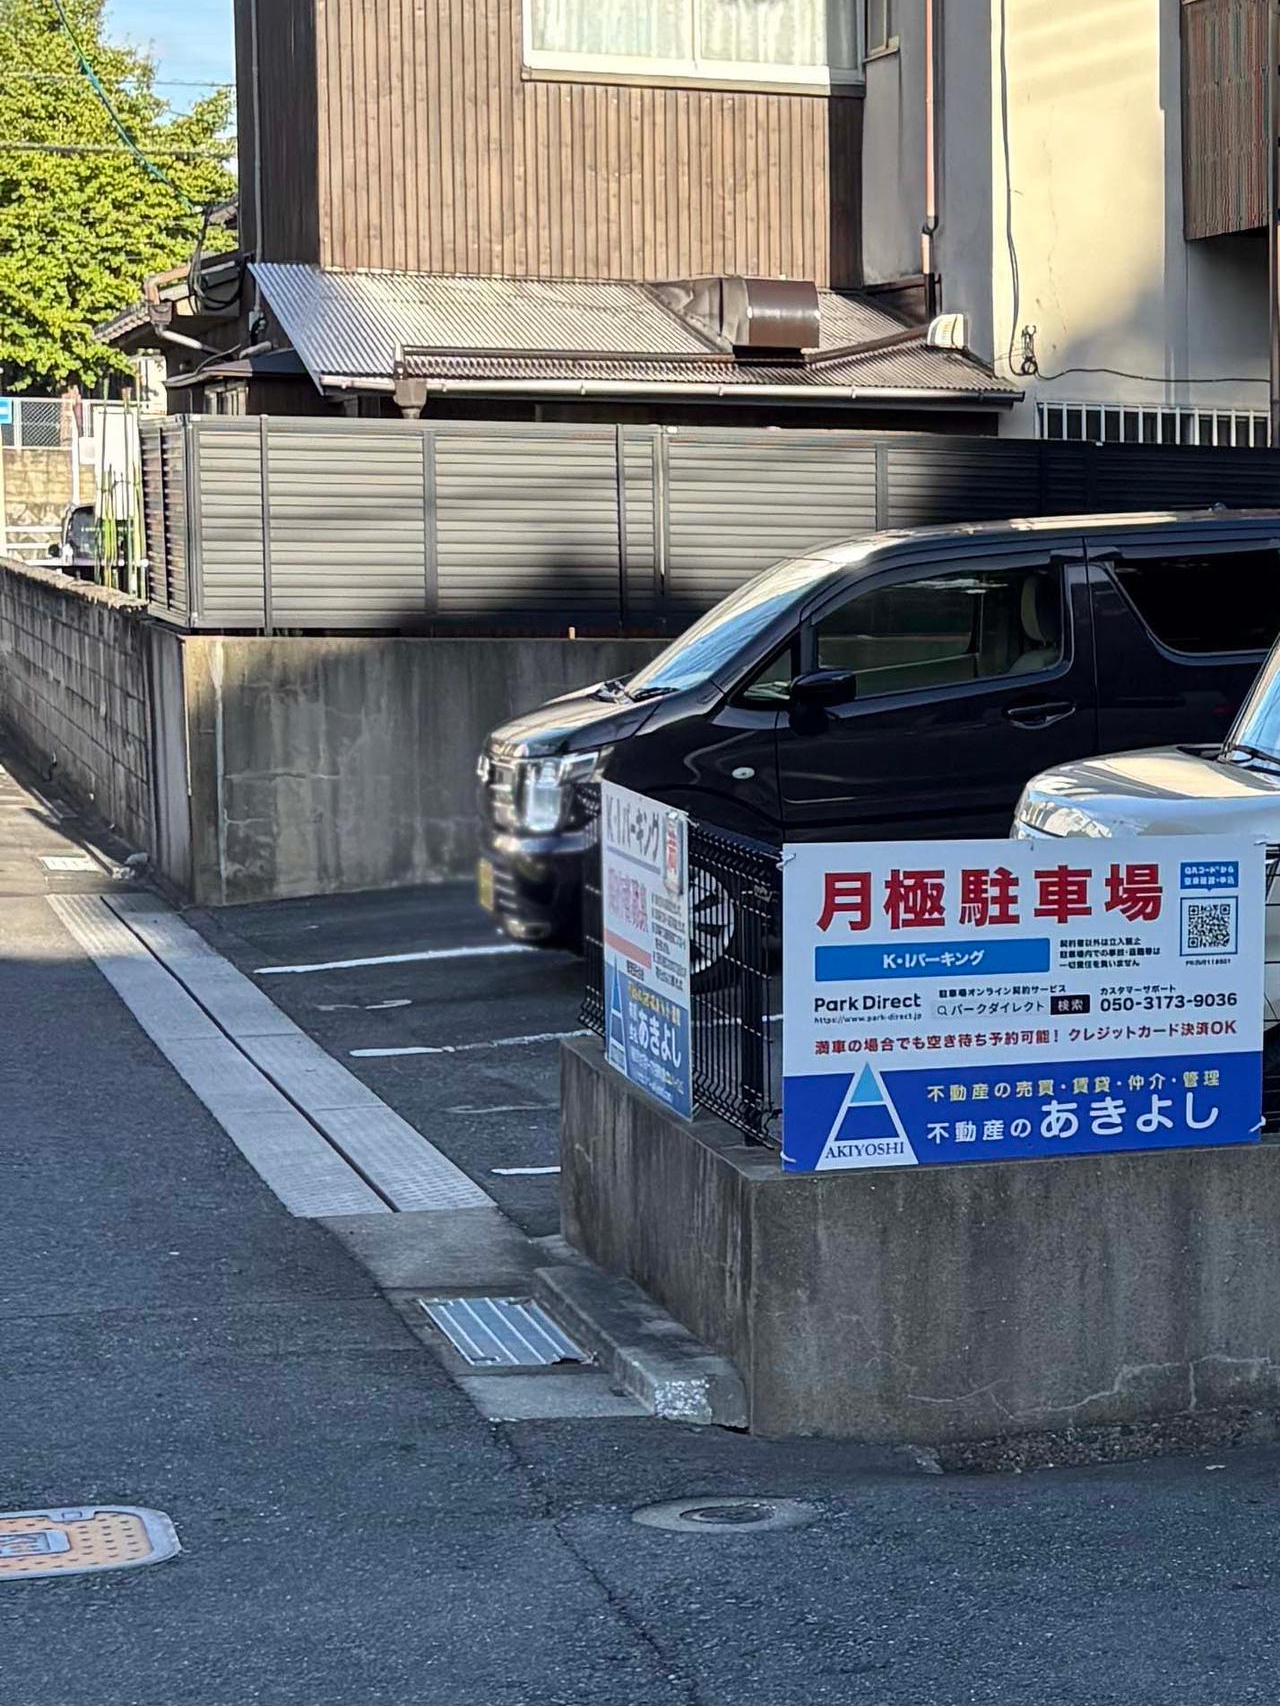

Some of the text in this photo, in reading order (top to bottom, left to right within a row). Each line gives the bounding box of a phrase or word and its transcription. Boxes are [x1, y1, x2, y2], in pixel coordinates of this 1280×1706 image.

[815, 863, 1164, 933] 月極駐車場
[938, 984, 1068, 999] 駐車場オンライン契約サービス
[1099, 983, 1177, 996] カスタマーサポート
[814, 992, 922, 1013] Park Direct
[950, 1000, 1046, 1015] パークダイレクト
[1057, 998, 1084, 1012] 検索
[1099, 992, 1238, 1012] 050-3173-9036
[638, 1009, 682, 1069] あきよし
[1068, 1019, 1238, 1042] クレジットカード決済OK
[825, 1141, 905, 1160] AKIYOSHI
